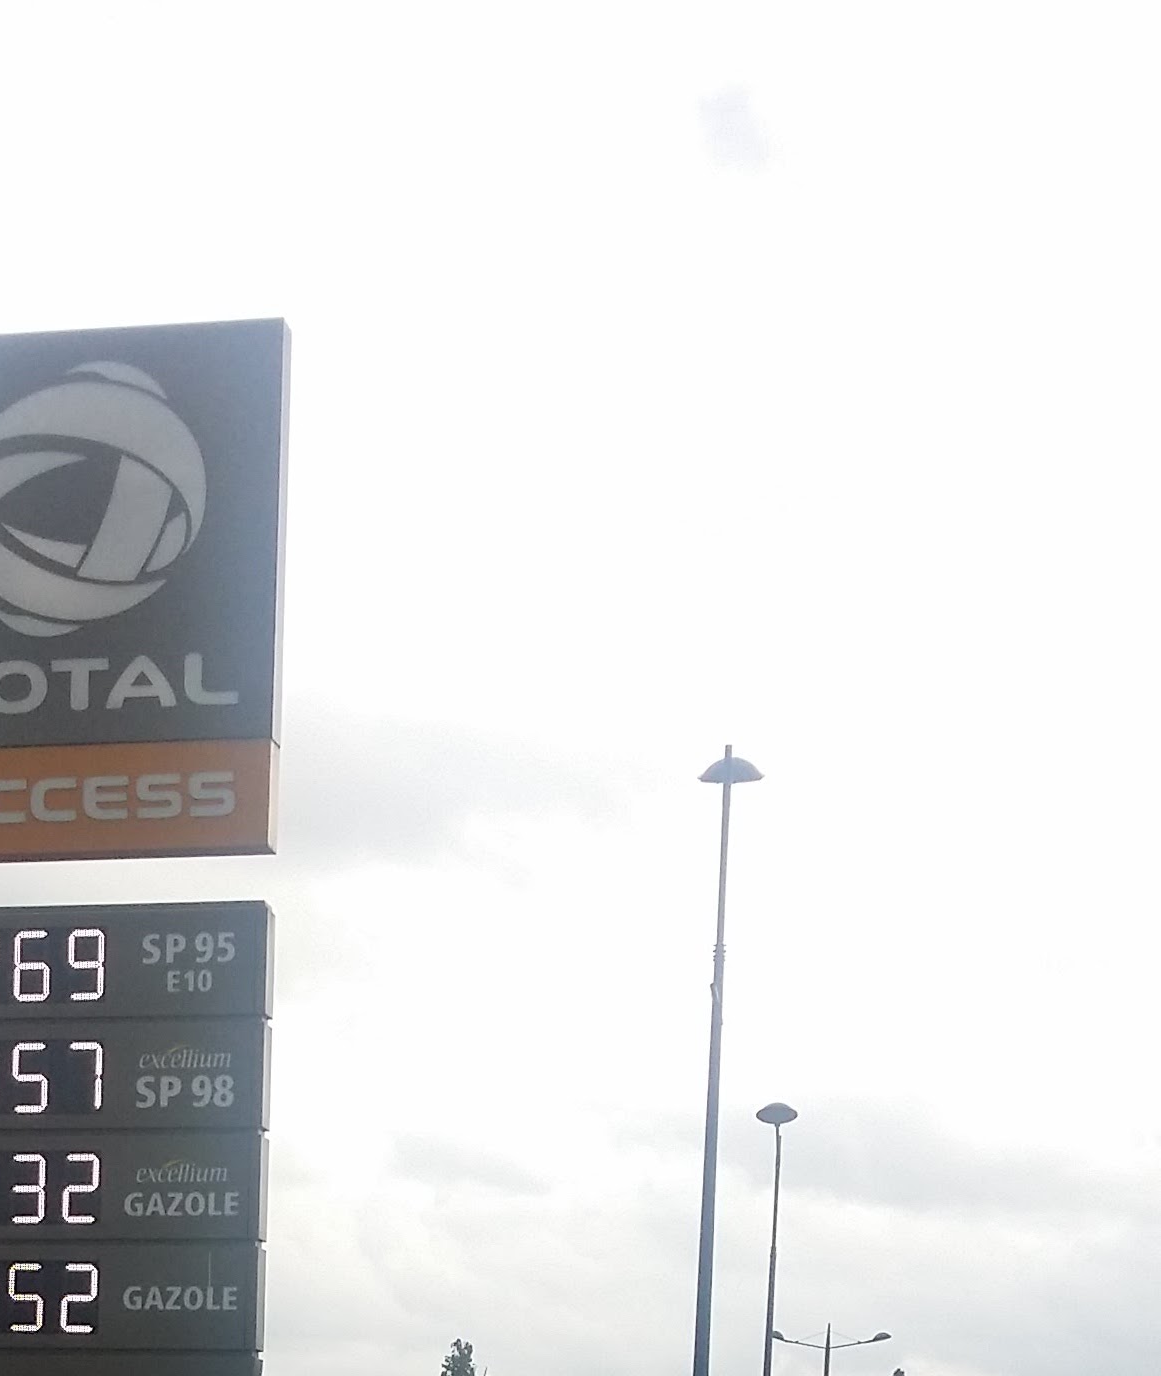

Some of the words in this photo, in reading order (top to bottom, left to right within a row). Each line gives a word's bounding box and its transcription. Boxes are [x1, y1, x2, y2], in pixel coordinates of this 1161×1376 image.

[166, 969, 213, 993] E10
[139, 1048, 232, 1069] excellium
[136, 1163, 228, 1183] excellium
[123, 1191, 239, 1217] GAZOLE
[122, 1285, 238, 1310] GAZOLE
